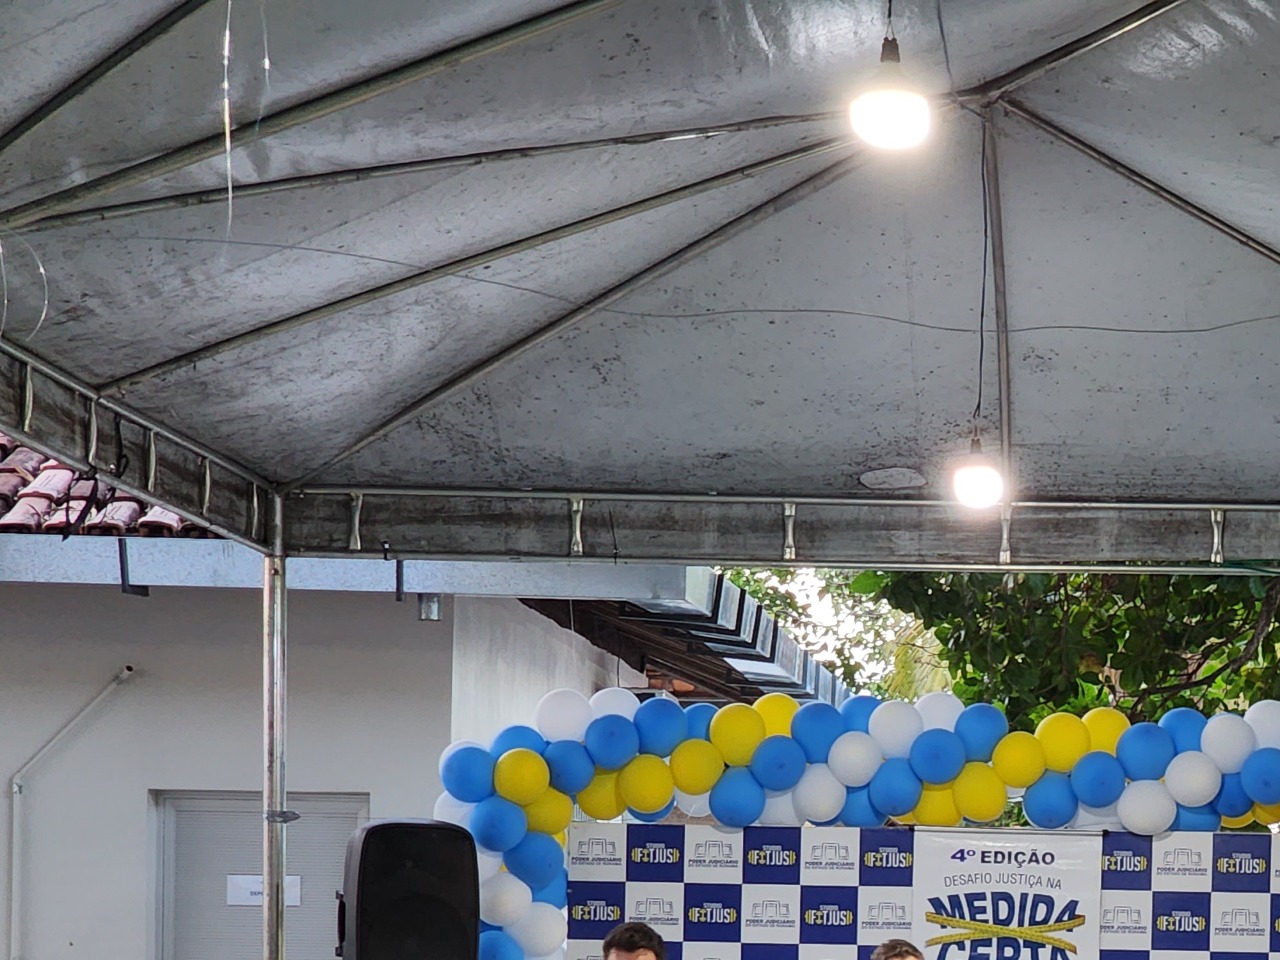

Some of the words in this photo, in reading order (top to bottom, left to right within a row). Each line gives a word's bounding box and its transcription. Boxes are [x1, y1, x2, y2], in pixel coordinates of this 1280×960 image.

[950, 849, 976, 862] 4º
[980, 849, 1055, 868] EDIÇÃO
[944, 872, 992, 887] DESAFIO
[995, 872, 1043, 888] JUSTIÇA
[1046, 877, 1061, 890] NA
[927, 891, 1080, 933] MEDIDA
